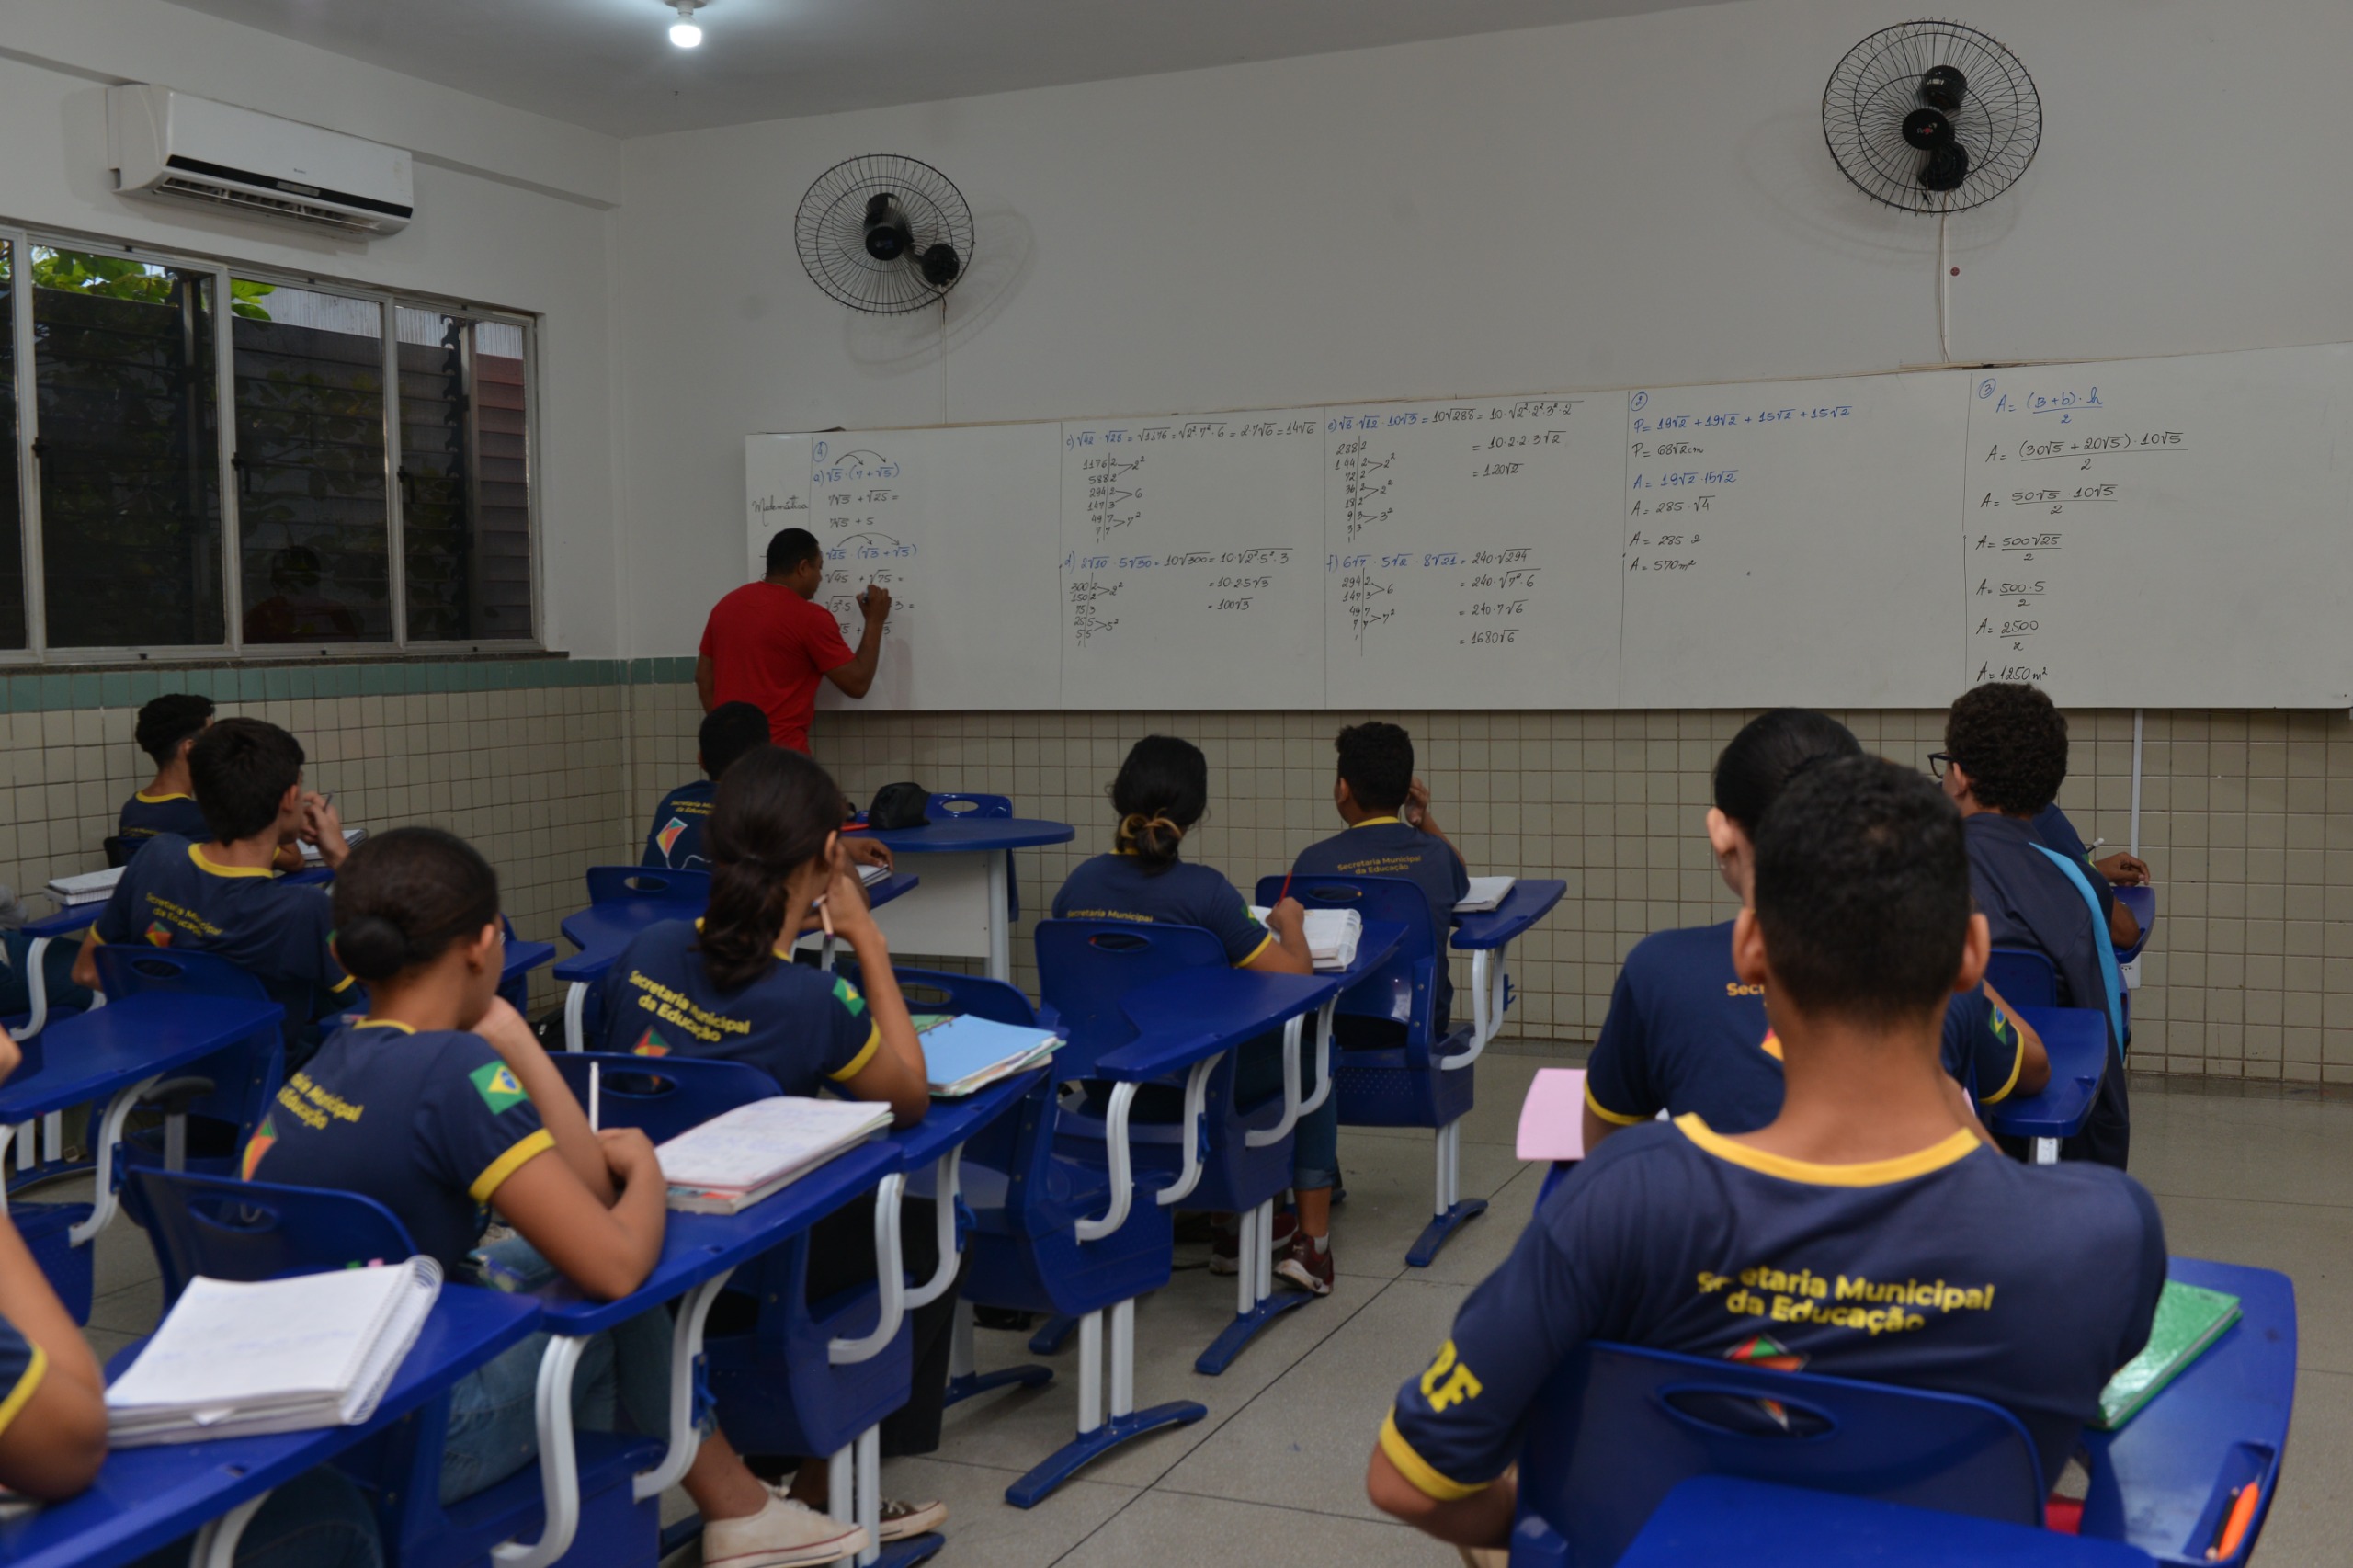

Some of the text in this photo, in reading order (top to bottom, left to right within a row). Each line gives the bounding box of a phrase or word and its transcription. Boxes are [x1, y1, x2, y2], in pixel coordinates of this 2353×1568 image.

[1337, 856, 1421, 871] Secretaria Municipal
[1369, 863, 1409, 873] Educação
[629, 971, 689, 1011] Secretaria
[638, 994, 722, 1042] da Educação
[1726, 1290, 1926, 1336] da Educação
[1835, 1274, 1995, 1313] Municipal
